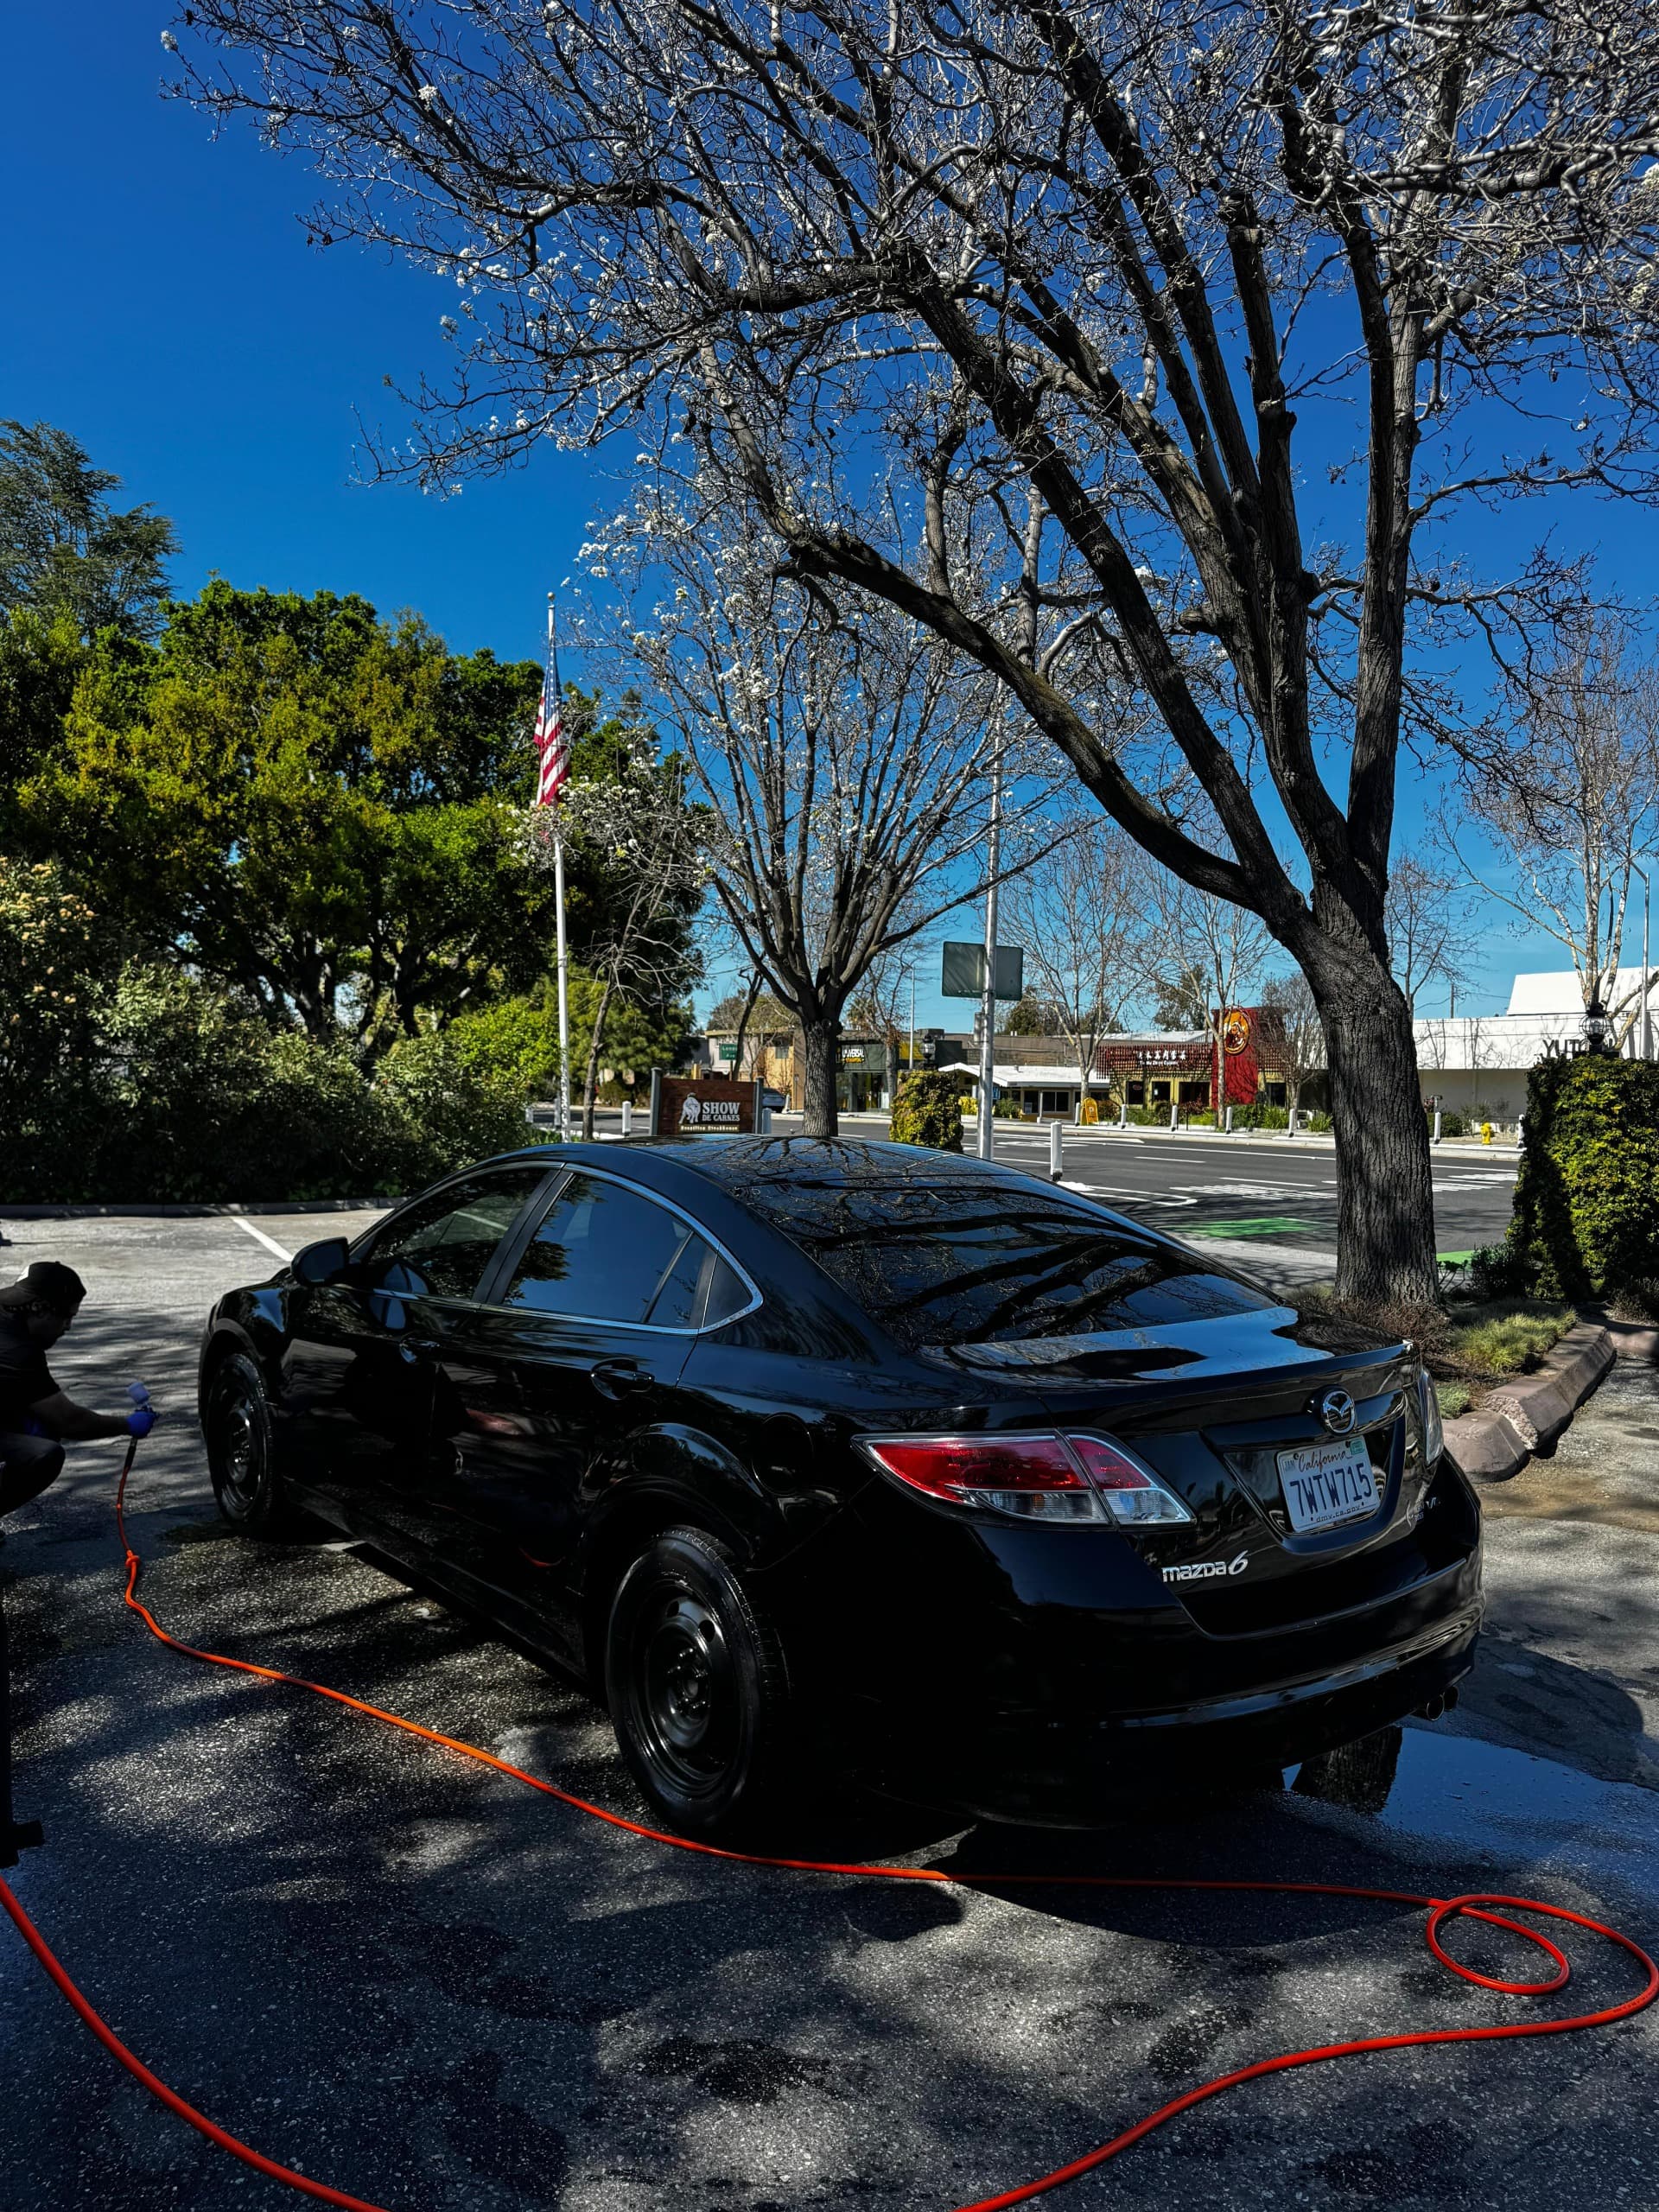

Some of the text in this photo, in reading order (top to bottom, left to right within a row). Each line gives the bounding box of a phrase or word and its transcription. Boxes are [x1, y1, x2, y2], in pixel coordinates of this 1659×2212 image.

[702, 1102, 741, 1115] SHOW
[1298, 1450, 1353, 1473] California
[1290, 1462, 1372, 1517] 7WTW715
